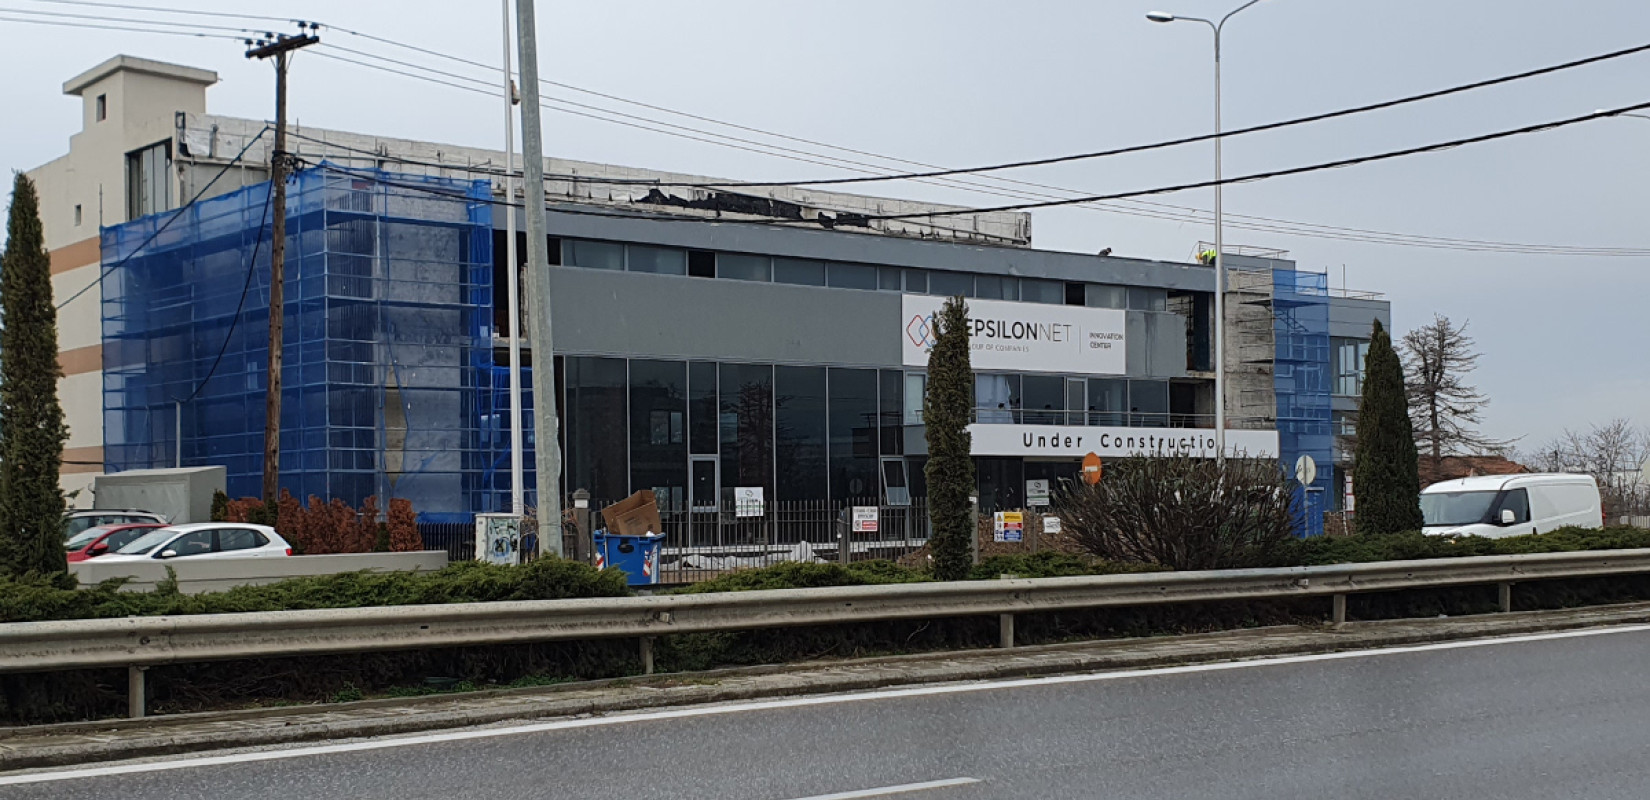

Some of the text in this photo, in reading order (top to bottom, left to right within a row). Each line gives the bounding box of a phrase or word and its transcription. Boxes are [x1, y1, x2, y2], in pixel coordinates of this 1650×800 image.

[995, 344, 1030, 353] COMPANIES
[1090, 341, 1112, 349] CENTER
[1023, 432, 1216, 450] Under Constructio
